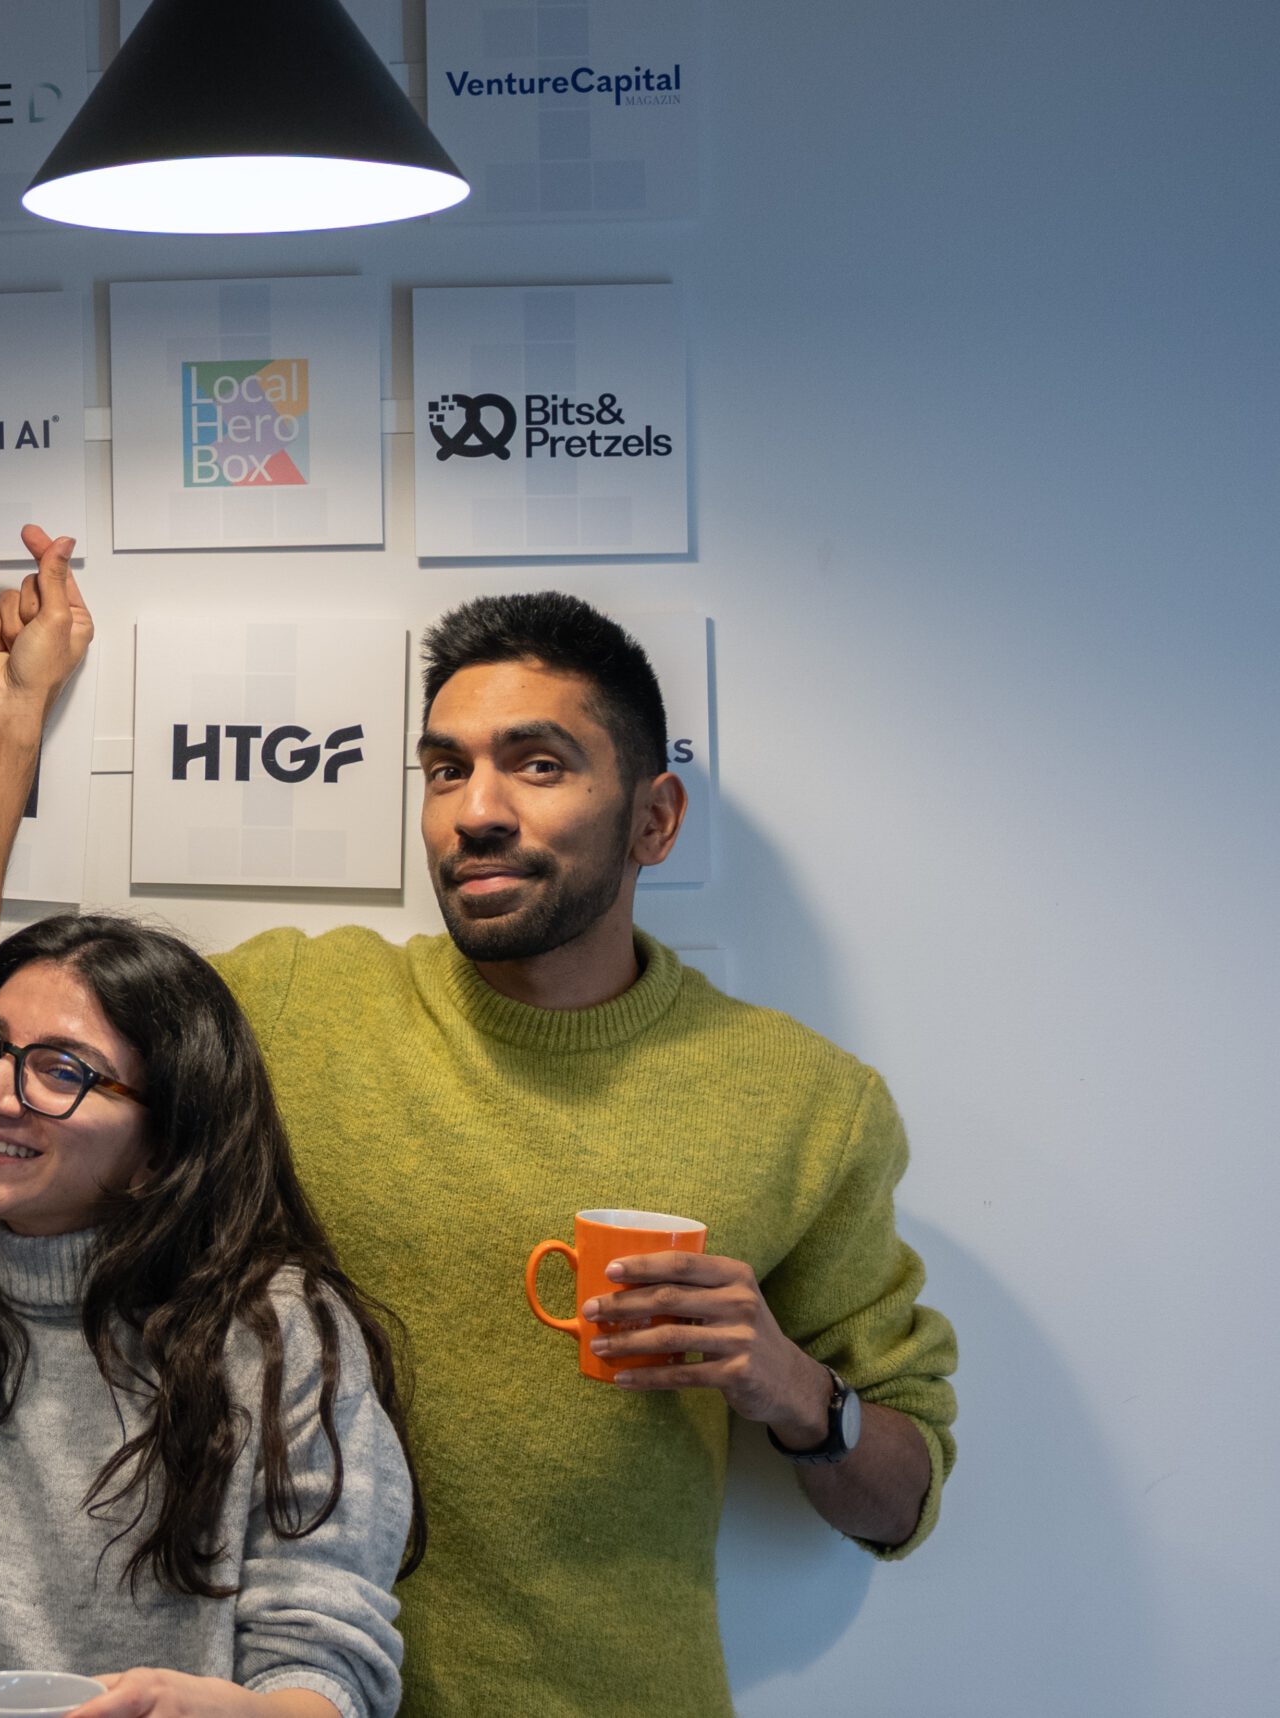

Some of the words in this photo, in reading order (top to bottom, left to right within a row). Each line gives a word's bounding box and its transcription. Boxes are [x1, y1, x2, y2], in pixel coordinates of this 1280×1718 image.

[446, 64, 680, 106] VentureCapital
[191, 362, 298, 404] Local
[192, 405, 300, 444] Hero
[525, 393, 625, 426] Bits&
[525, 425, 672, 458] Pretzels
[192, 445, 272, 484] Box
[172, 724, 364, 784] HTGF
